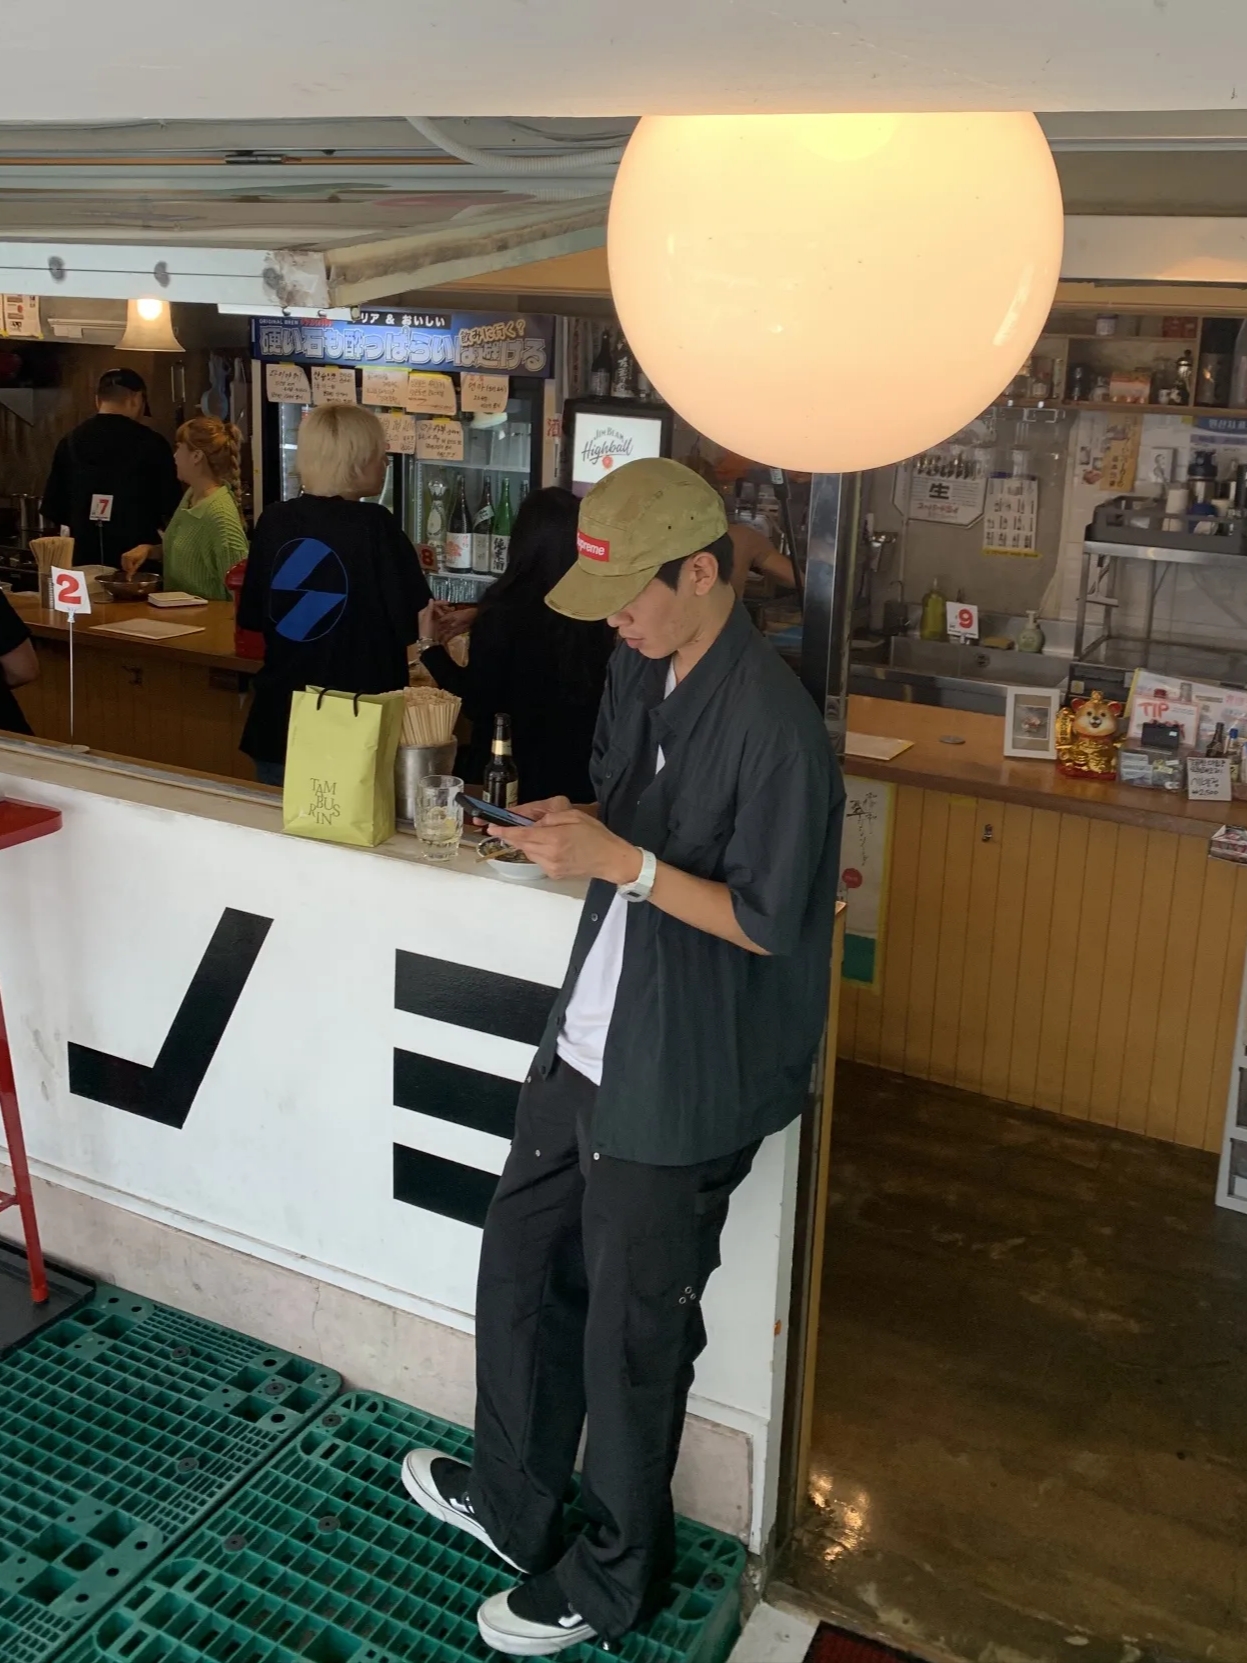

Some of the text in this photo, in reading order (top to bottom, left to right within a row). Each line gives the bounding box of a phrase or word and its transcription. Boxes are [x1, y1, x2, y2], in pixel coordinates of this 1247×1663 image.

[259, 318, 284, 326] ORIGINAL
[353, 313, 446, 327] リア & おいしい
[593, 427, 625, 441] JIM BEAM
[581, 437, 635, 465] Highball
[929, 483, 950, 499] 生
[99, 499, 109, 514] 7
[421, 548, 433, 566] 8
[56, 573, 82, 605] 2
[958, 608, 974, 629] 9
[1138, 702, 1169, 718] TIP
